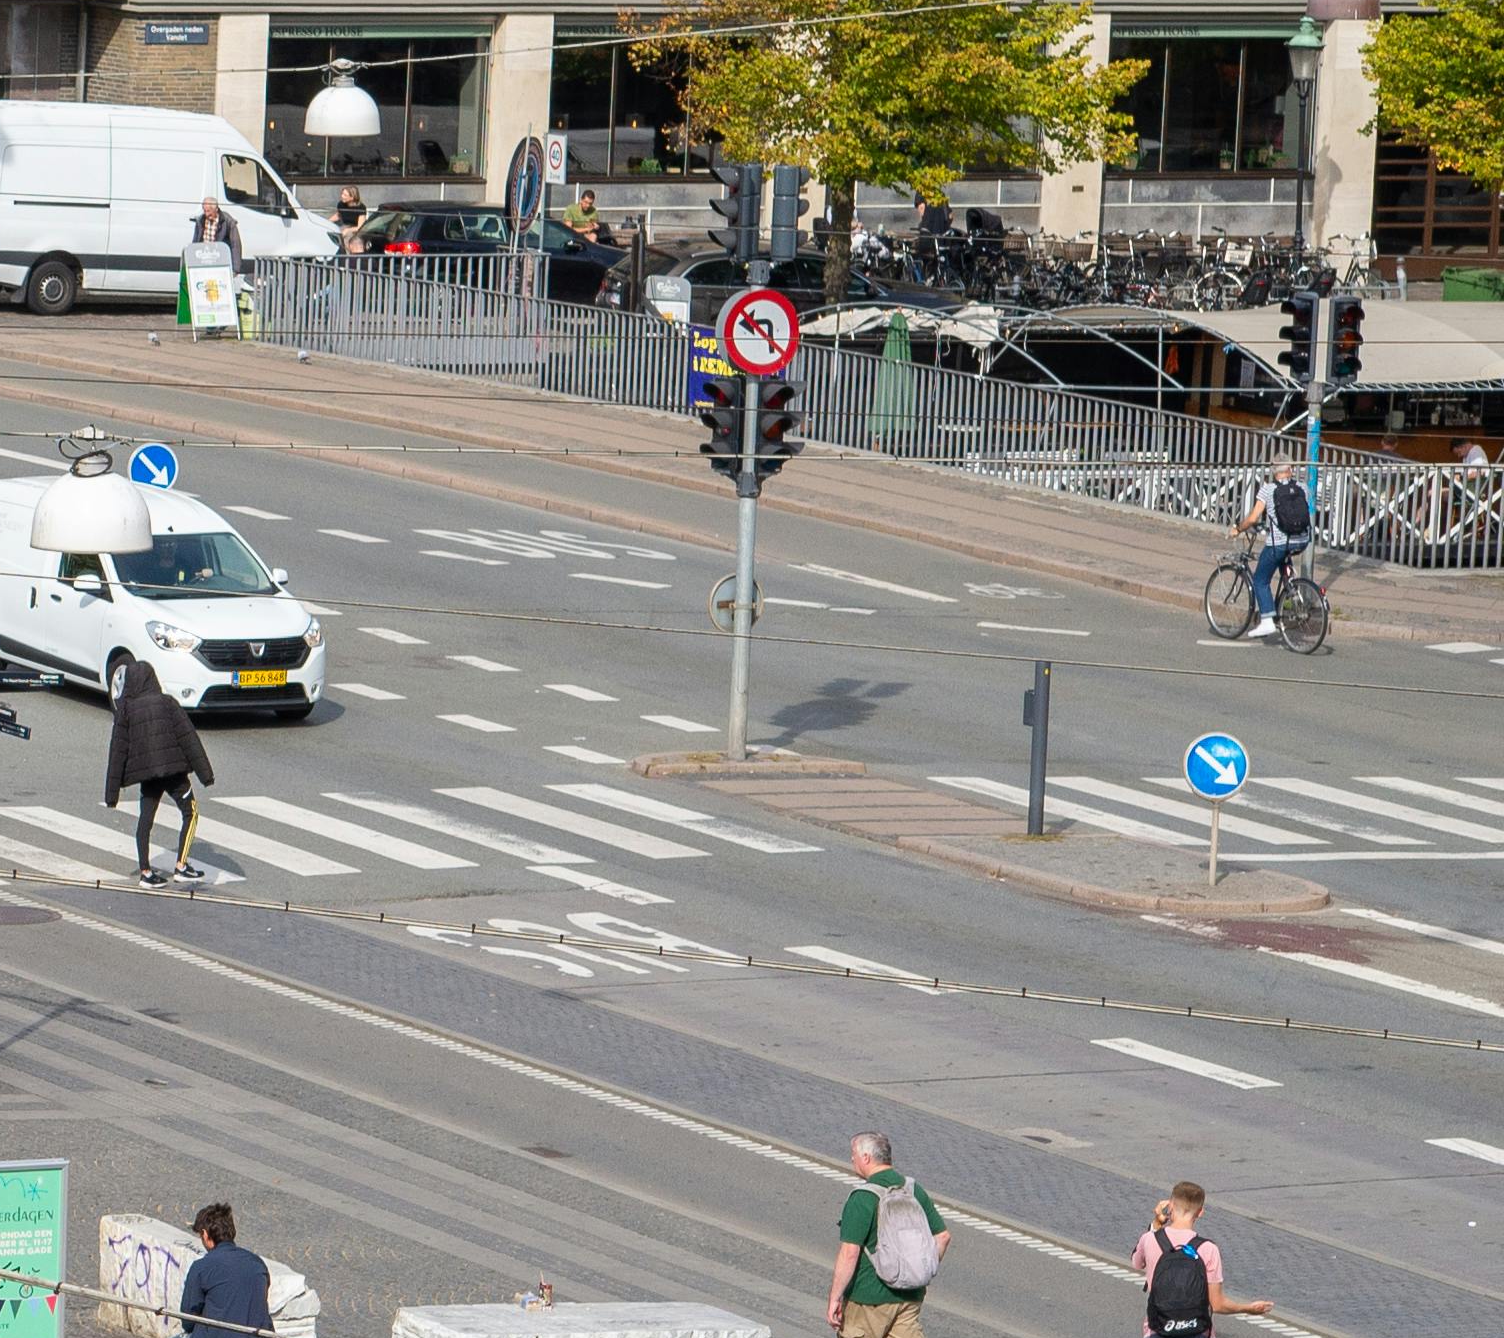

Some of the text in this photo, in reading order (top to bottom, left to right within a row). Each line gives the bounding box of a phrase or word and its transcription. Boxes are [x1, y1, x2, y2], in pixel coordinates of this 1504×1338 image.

[325, 27, 364, 37] HOUSE
[552, 150, 560, 161] 40
[240, 674, 252, 683] BP
[255, 673, 265, 683] 56
[34, 1229, 53, 1237] DEN
[27, 1247, 52, 1255] GADE
[1175, 1318, 1198, 1330] asics
